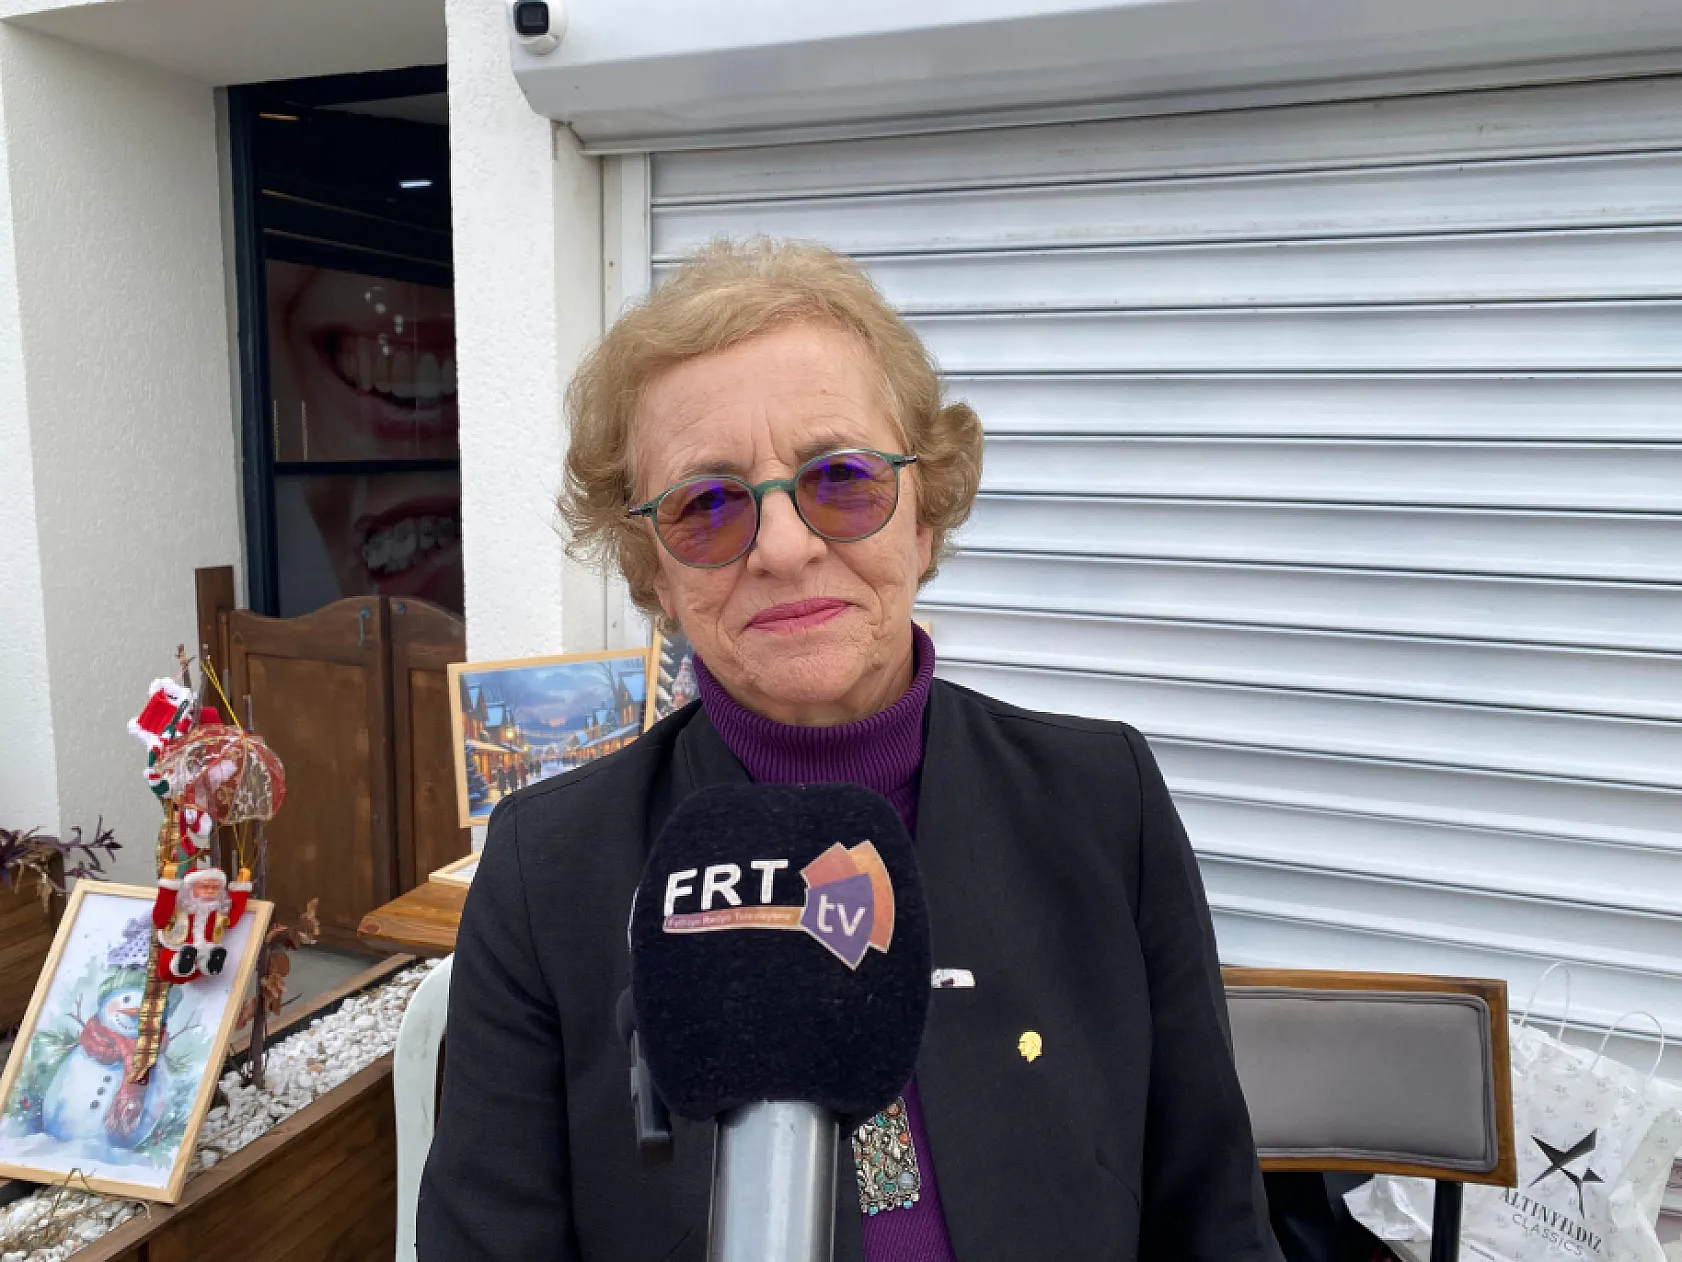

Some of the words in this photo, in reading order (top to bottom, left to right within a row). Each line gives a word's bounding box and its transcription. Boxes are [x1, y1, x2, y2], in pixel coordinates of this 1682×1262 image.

[664, 858, 789, 917] FRT
[817, 893, 866, 936] tv
[1512, 1213, 1583, 1256] CLASSICS
